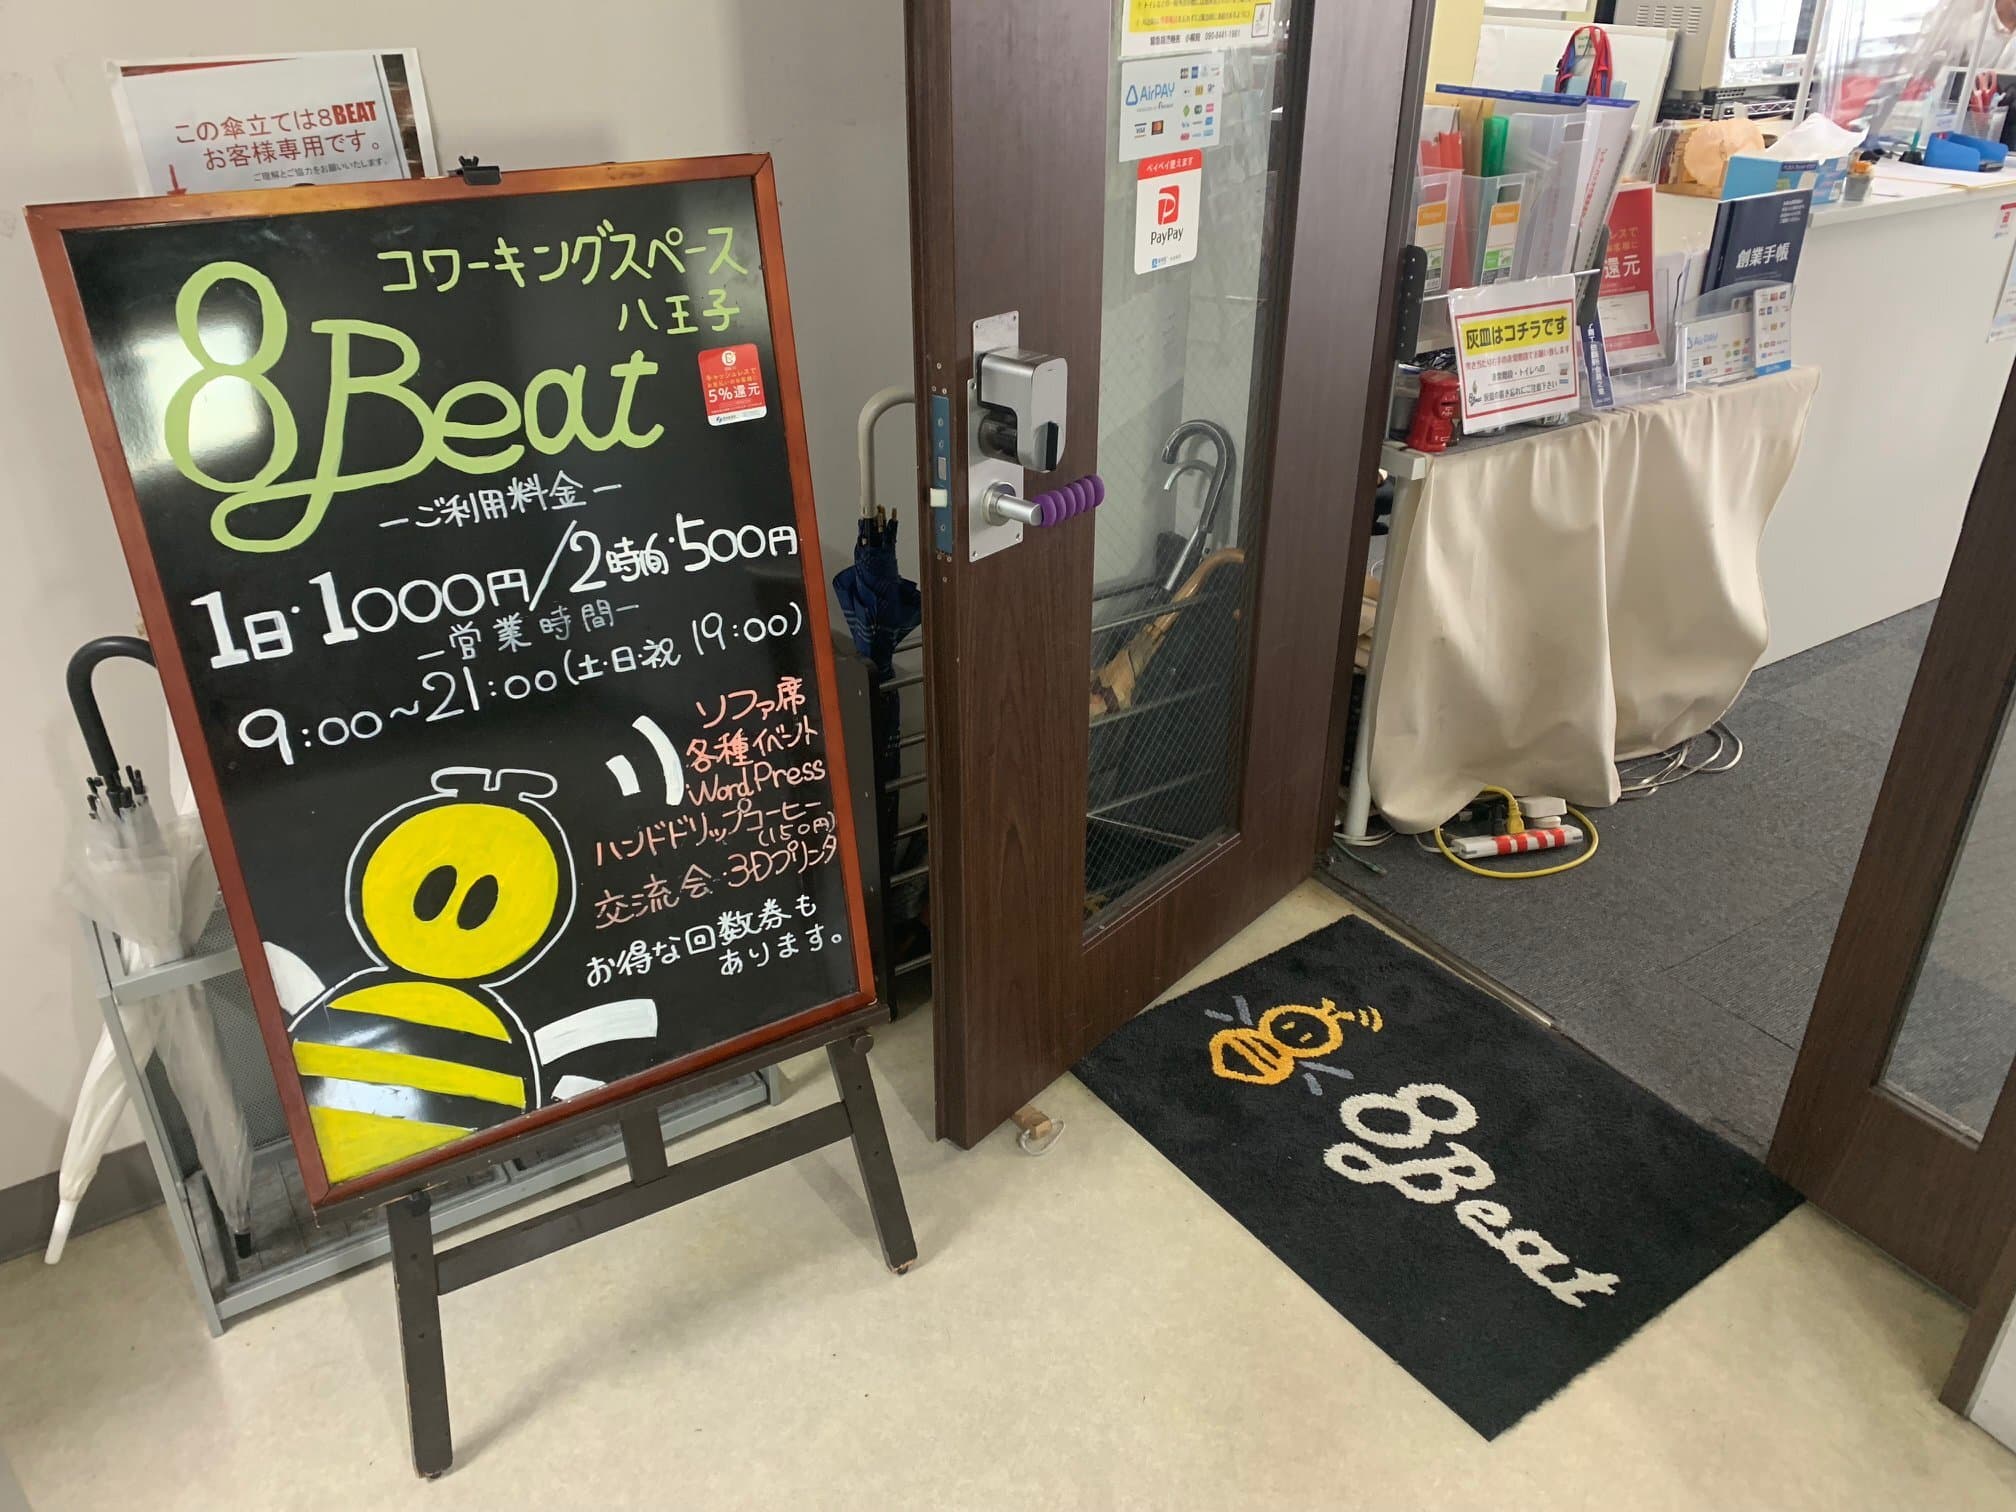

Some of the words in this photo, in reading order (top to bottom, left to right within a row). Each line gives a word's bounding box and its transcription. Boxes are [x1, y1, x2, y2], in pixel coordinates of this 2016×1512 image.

[174, 100, 377, 144] この傘立ては8BEAT
[203, 129, 381, 171] お客様専用です。
[377, 219, 748, 292] コワーキングスペース
[1150, 227, 1183, 246] PayPay
[1735, 241, 1791, 269] 創業手帳
[618, 288, 740, 335] 八王子
[1465, 316, 1568, 350] 灰皿はコチラです
[708, 382, 761, 403] 5%還元
[695, 676, 806, 729] ソファ席
[686, 715, 818, 772] 各種イベント
[596, 797, 822, 866] ハンドドリップコーヒー
[758, 811, 837, 847] (150円)
[586, 893, 817, 987] お得な回数券も
[719, 923, 842, 976] あります。
